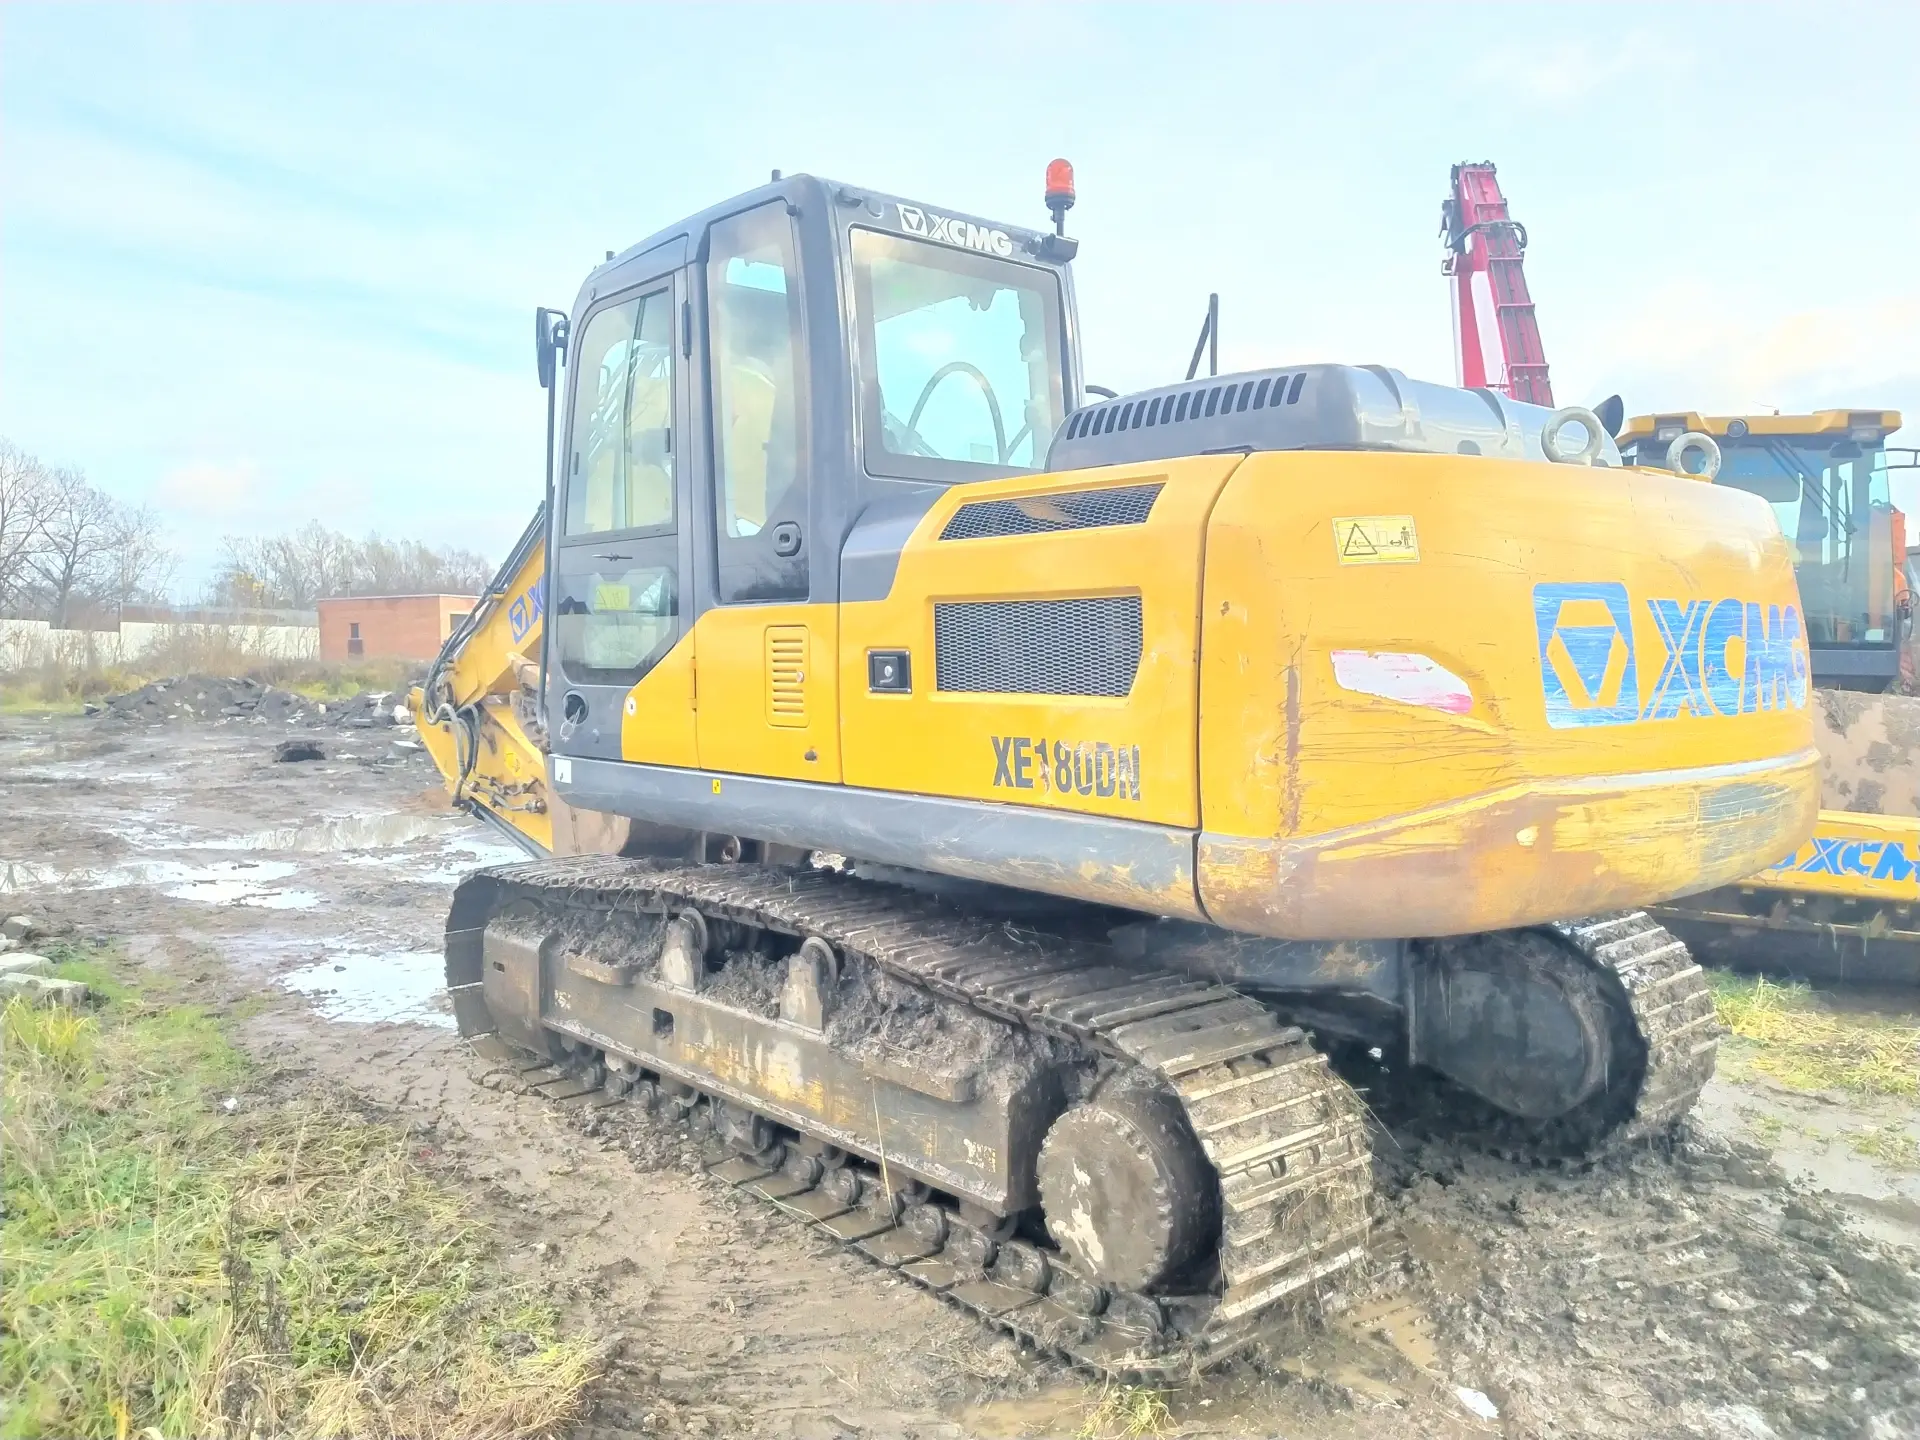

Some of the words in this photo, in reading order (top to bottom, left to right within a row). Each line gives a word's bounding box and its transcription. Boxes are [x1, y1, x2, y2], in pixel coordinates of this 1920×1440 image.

[927, 213, 1012, 257] XCMG
[527, 573, 545, 627] X
[1640, 597, 1807, 720] XCMG
[990, 735, 1141, 802] XE180DN
